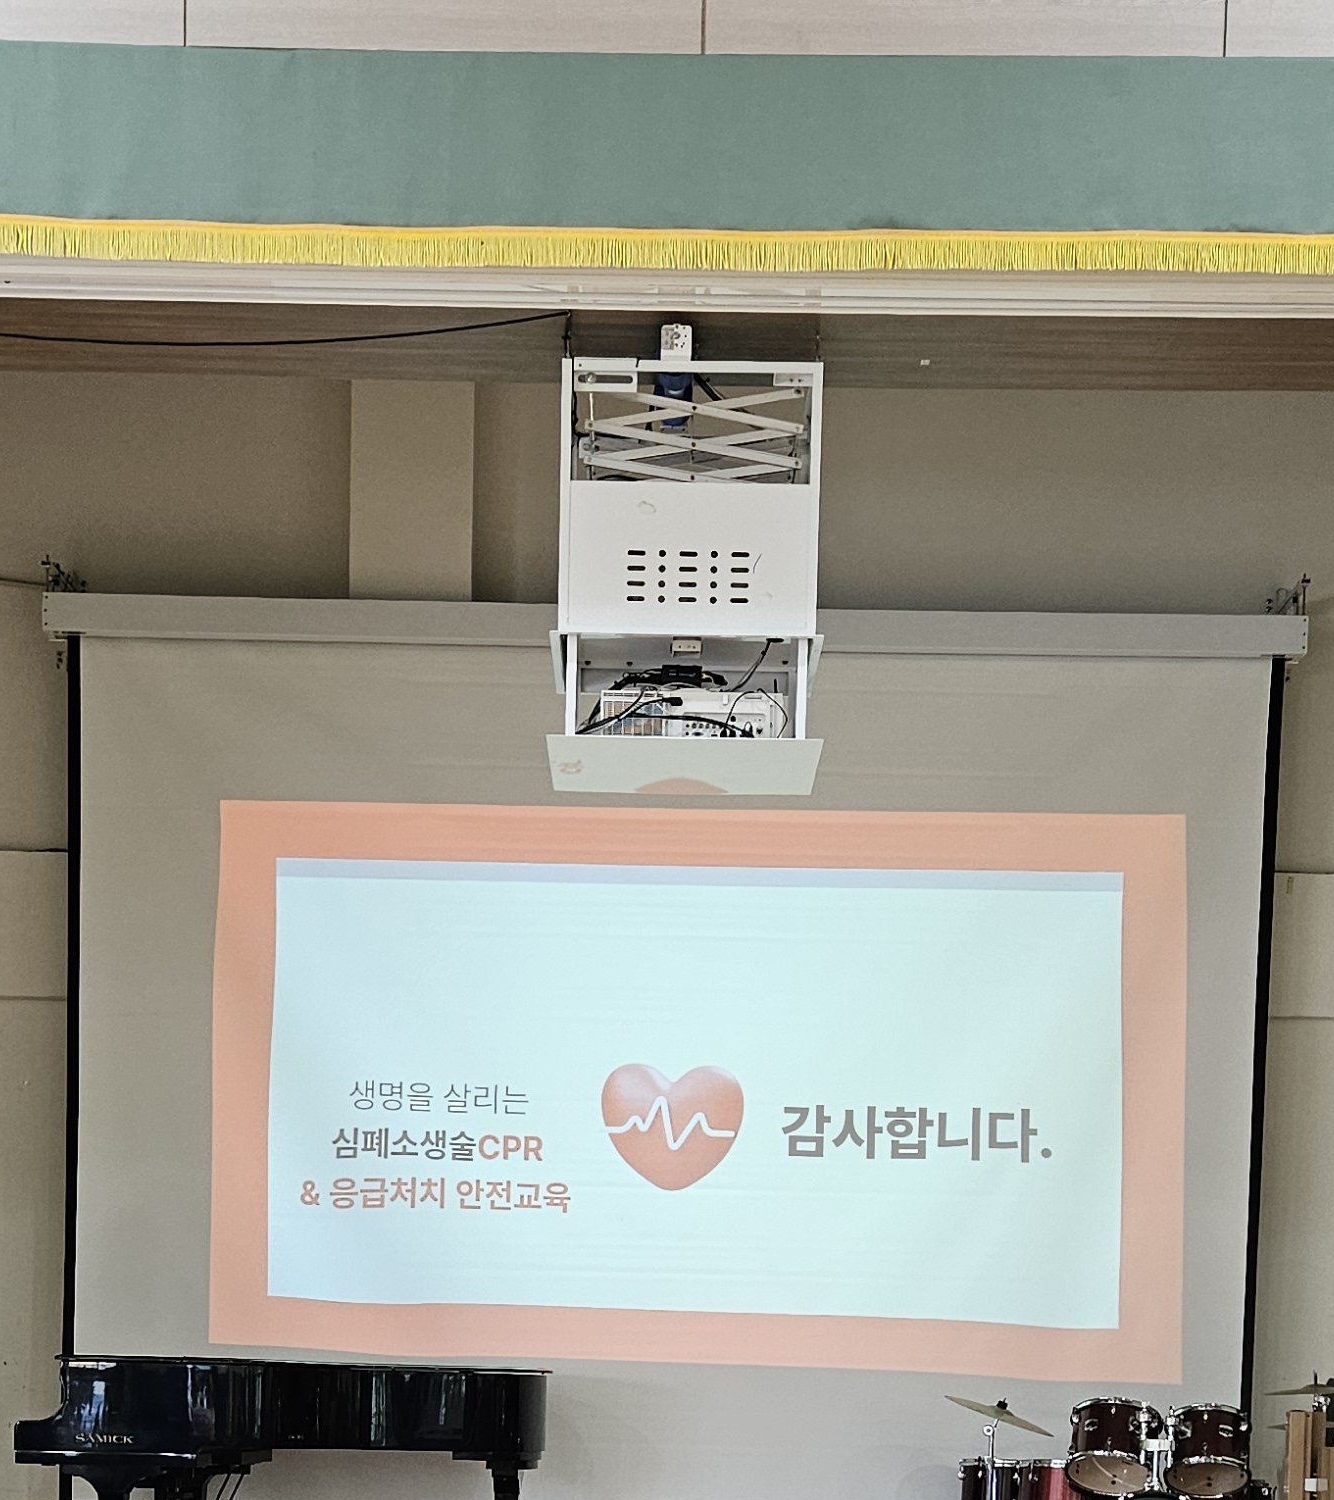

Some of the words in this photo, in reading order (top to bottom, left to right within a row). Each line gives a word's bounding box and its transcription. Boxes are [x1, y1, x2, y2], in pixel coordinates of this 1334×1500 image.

[349, 1080, 434, 1112] 생명을
[443, 1083, 529, 1115] 살리는
[331, 1127, 543, 1161] 심폐소생술CPR
[781, 1104, 1053, 1163] 감사합니다.
[299, 1180, 320, 1206] &
[329, 1177, 445, 1209] 응급처치
[456, 1179, 571, 1213] 안전교육
[75, 1433, 134, 1444] SAMICK
